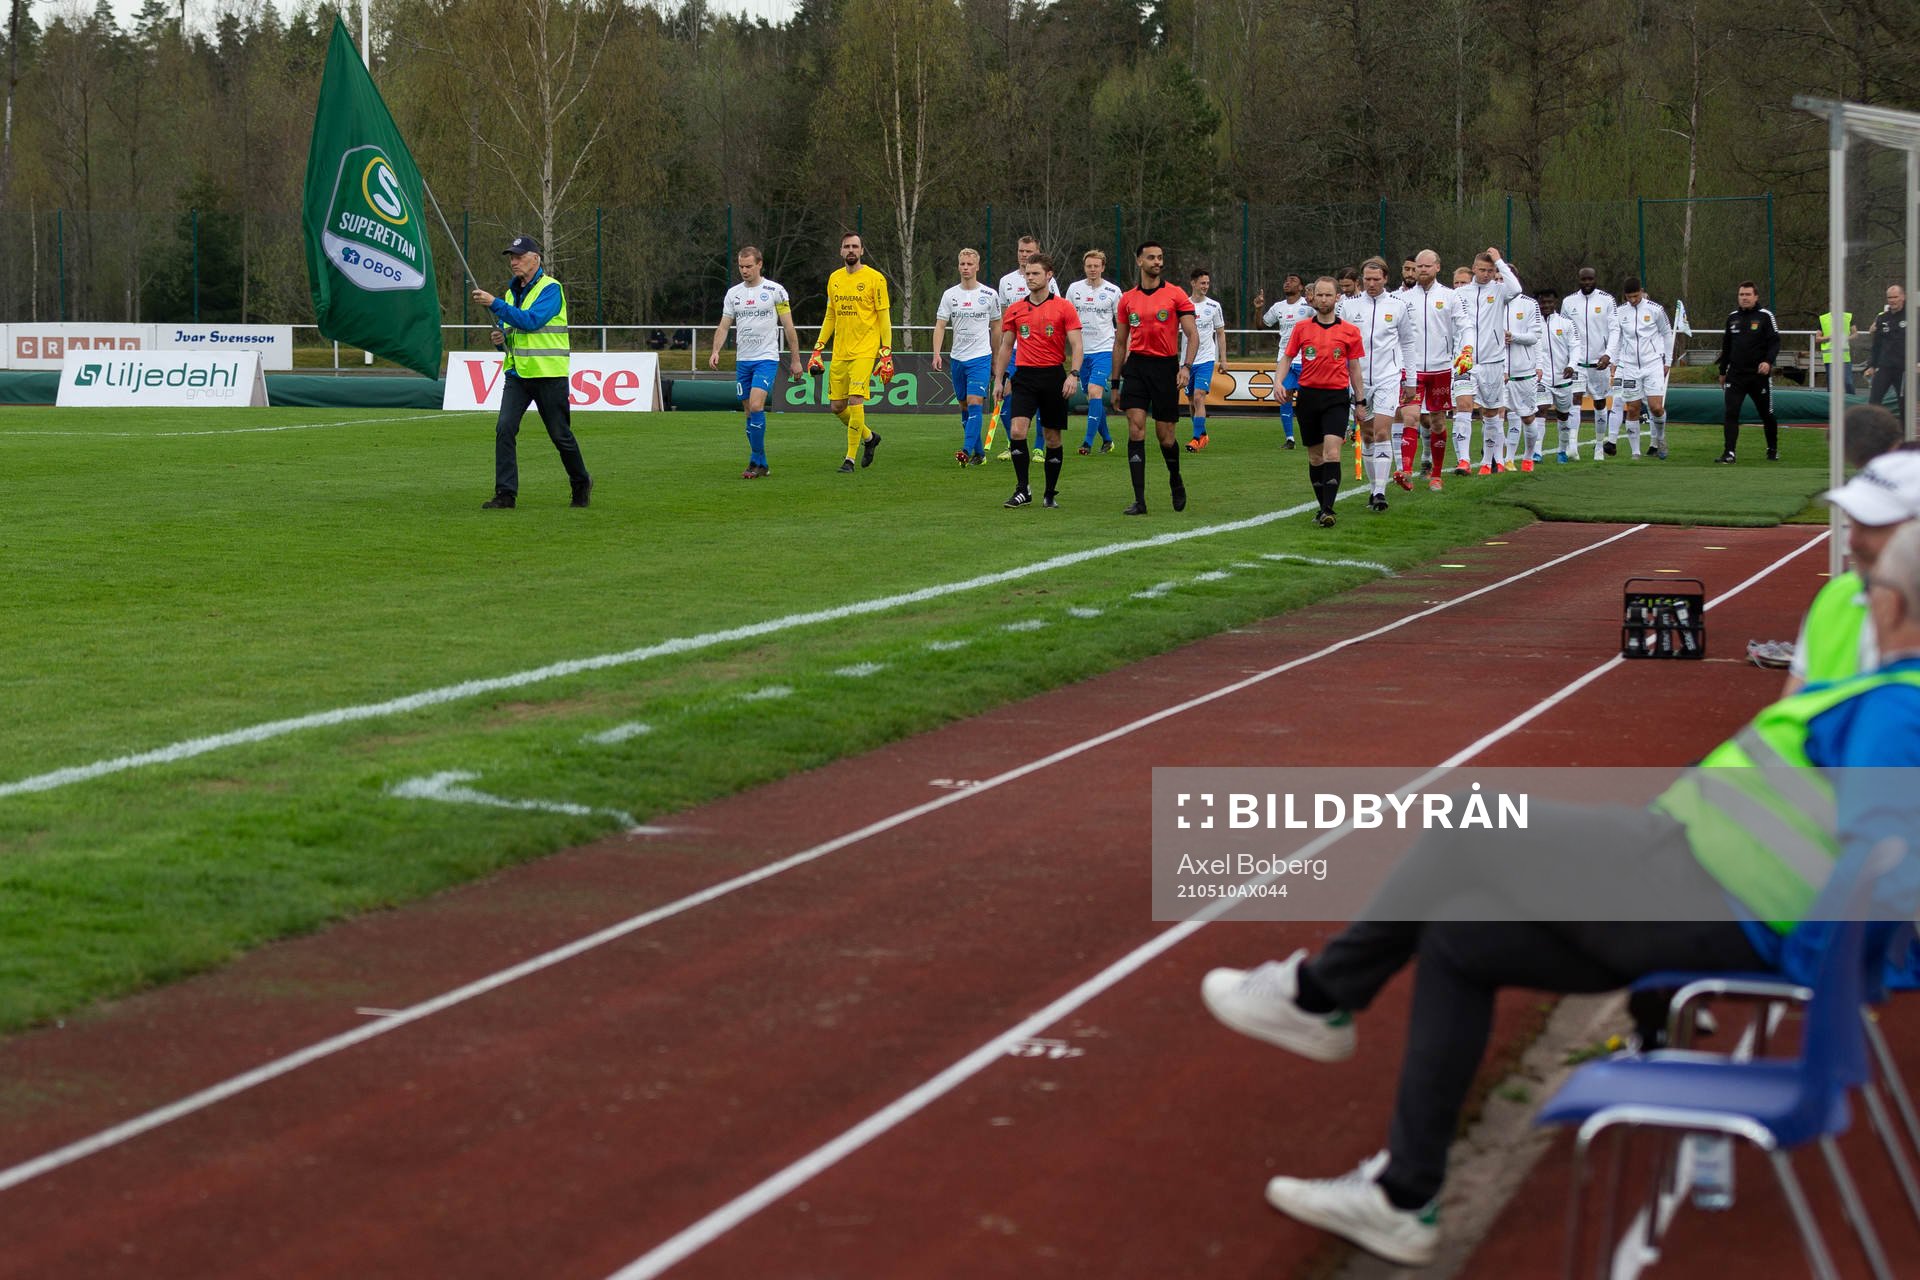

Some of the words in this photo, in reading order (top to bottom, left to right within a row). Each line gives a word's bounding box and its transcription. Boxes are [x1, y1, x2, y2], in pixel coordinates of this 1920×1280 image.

[339, 212, 416, 262] SUPERETTAN
[363, 258, 402, 282] OBOS
[209, 330, 275, 343] Svensson
[186, 388, 235, 400] group
